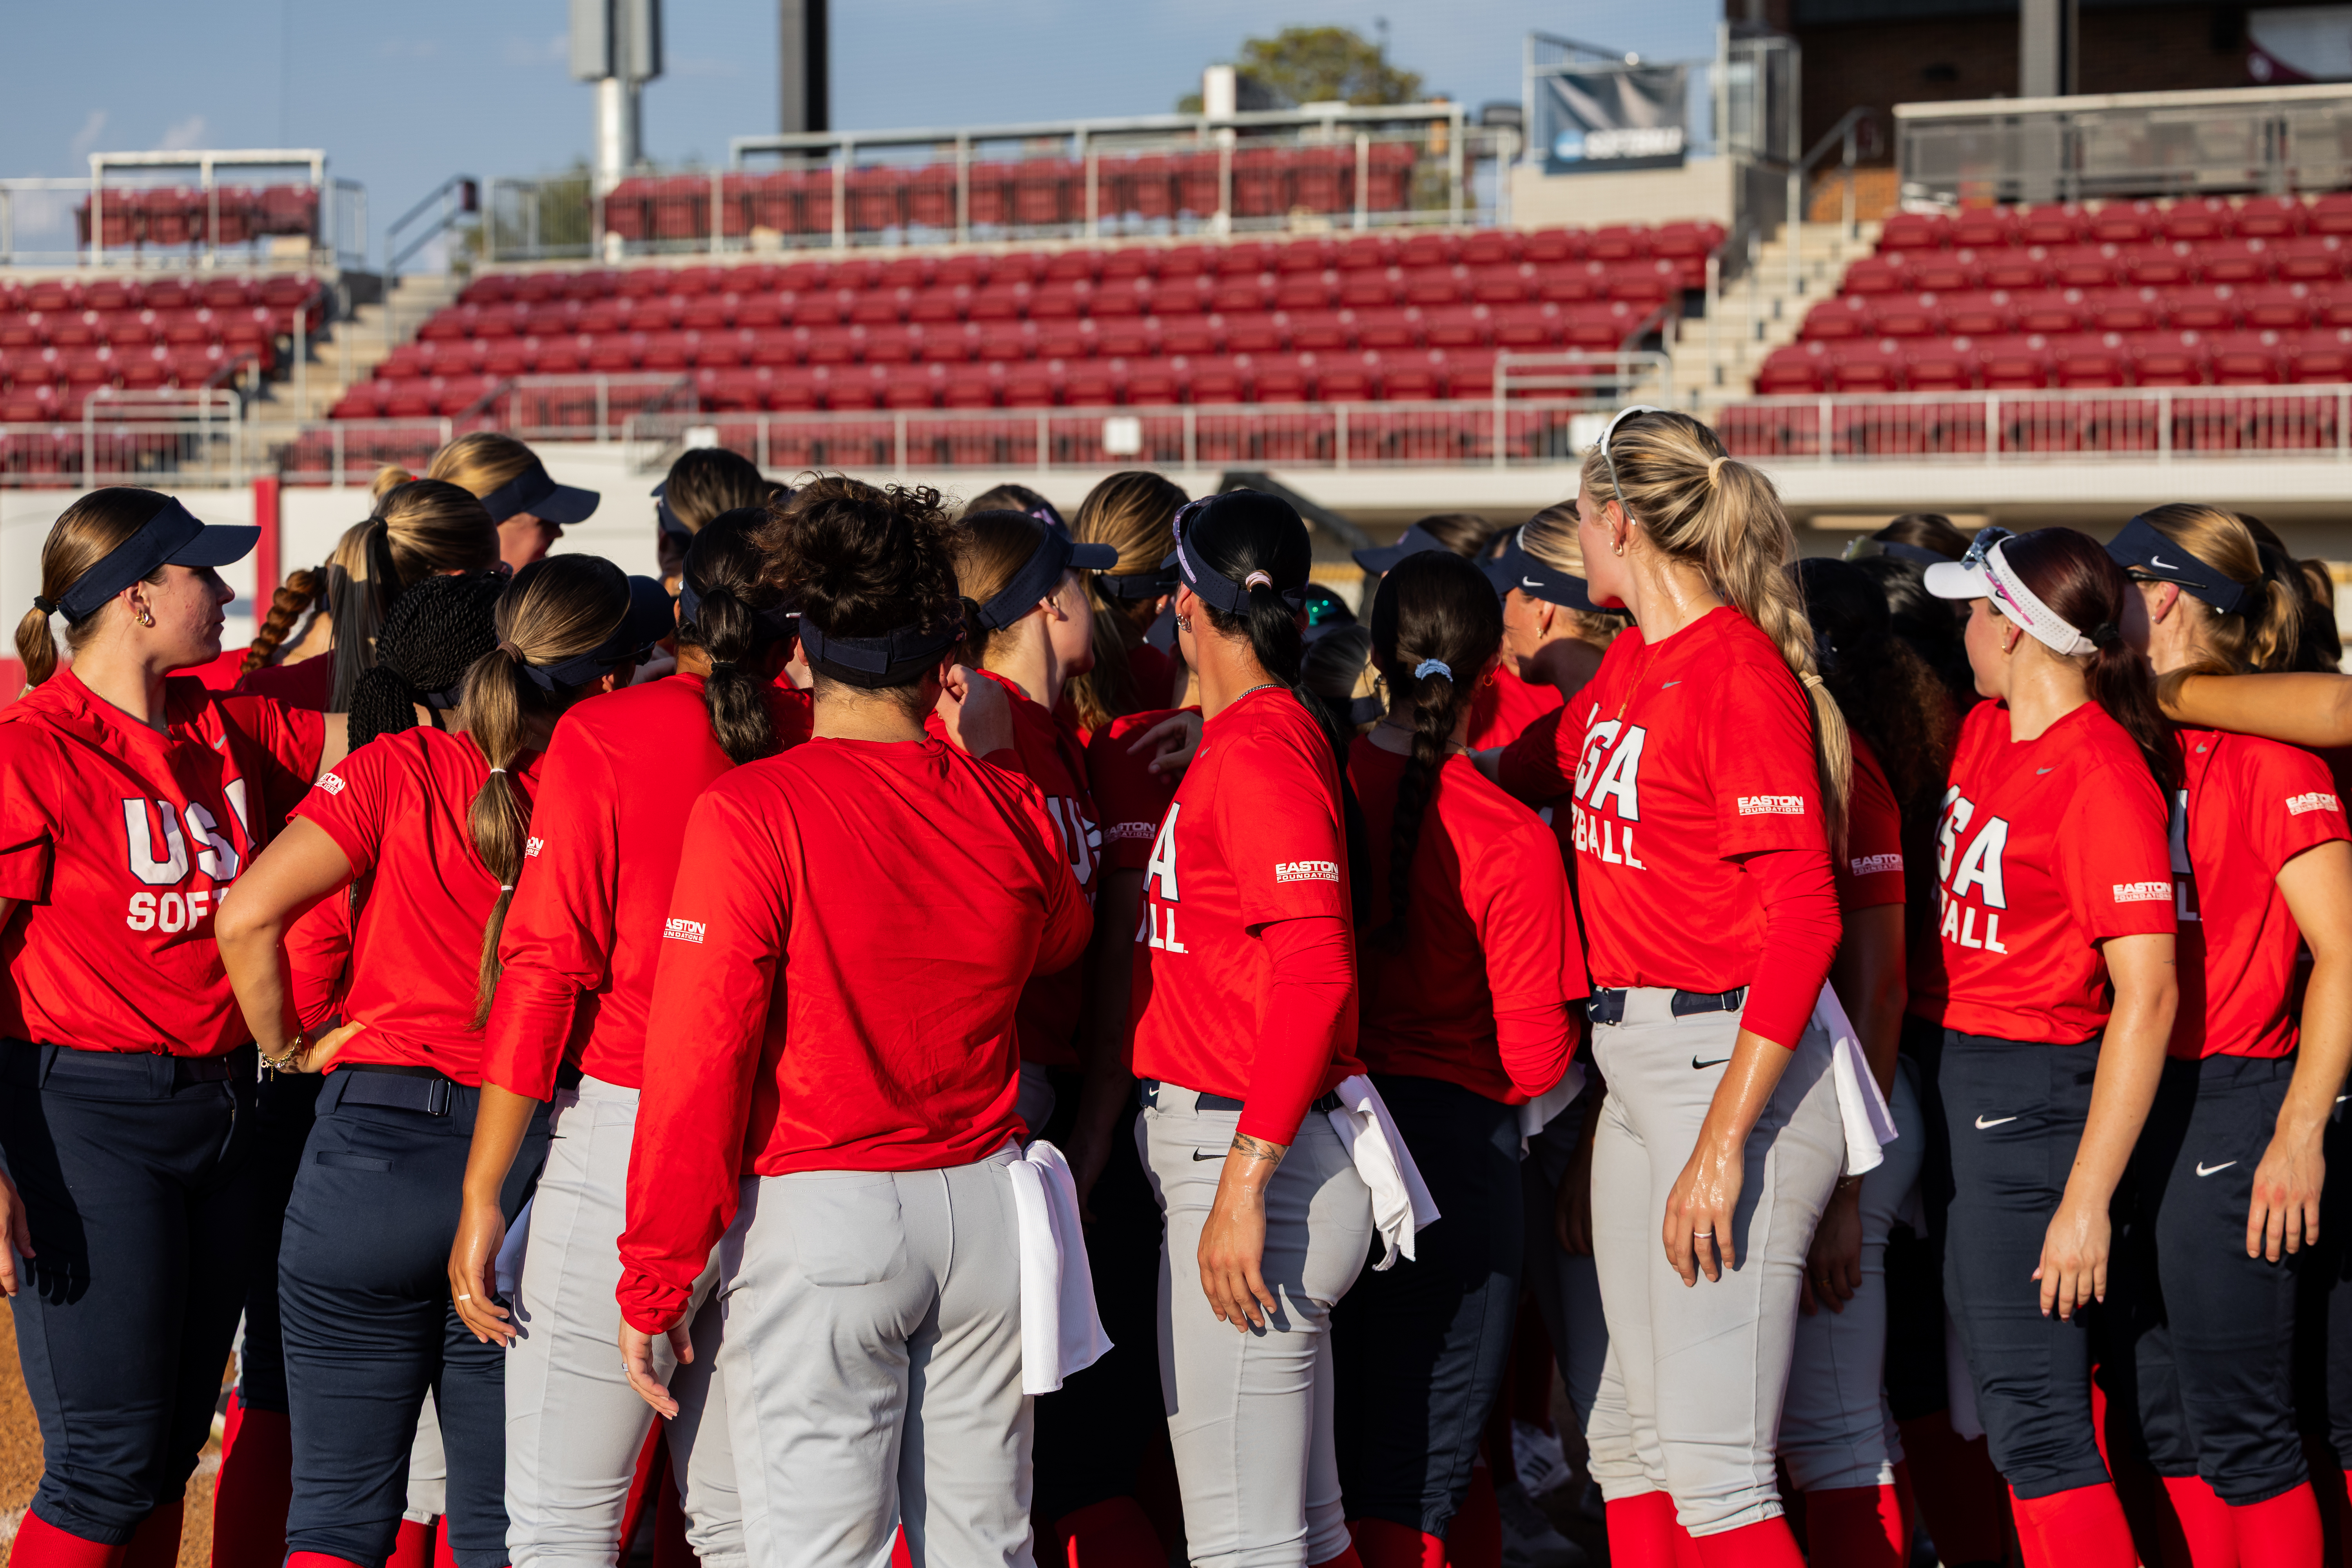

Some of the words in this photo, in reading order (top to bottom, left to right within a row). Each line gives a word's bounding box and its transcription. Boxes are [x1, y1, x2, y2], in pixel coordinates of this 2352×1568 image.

[1737, 795, 1804, 807] EASTON
[1276, 861, 1339, 874] EASTON
[1277, 873, 1339, 881] FOUNDATIONS
[2113, 882, 2172, 894] EASTON
